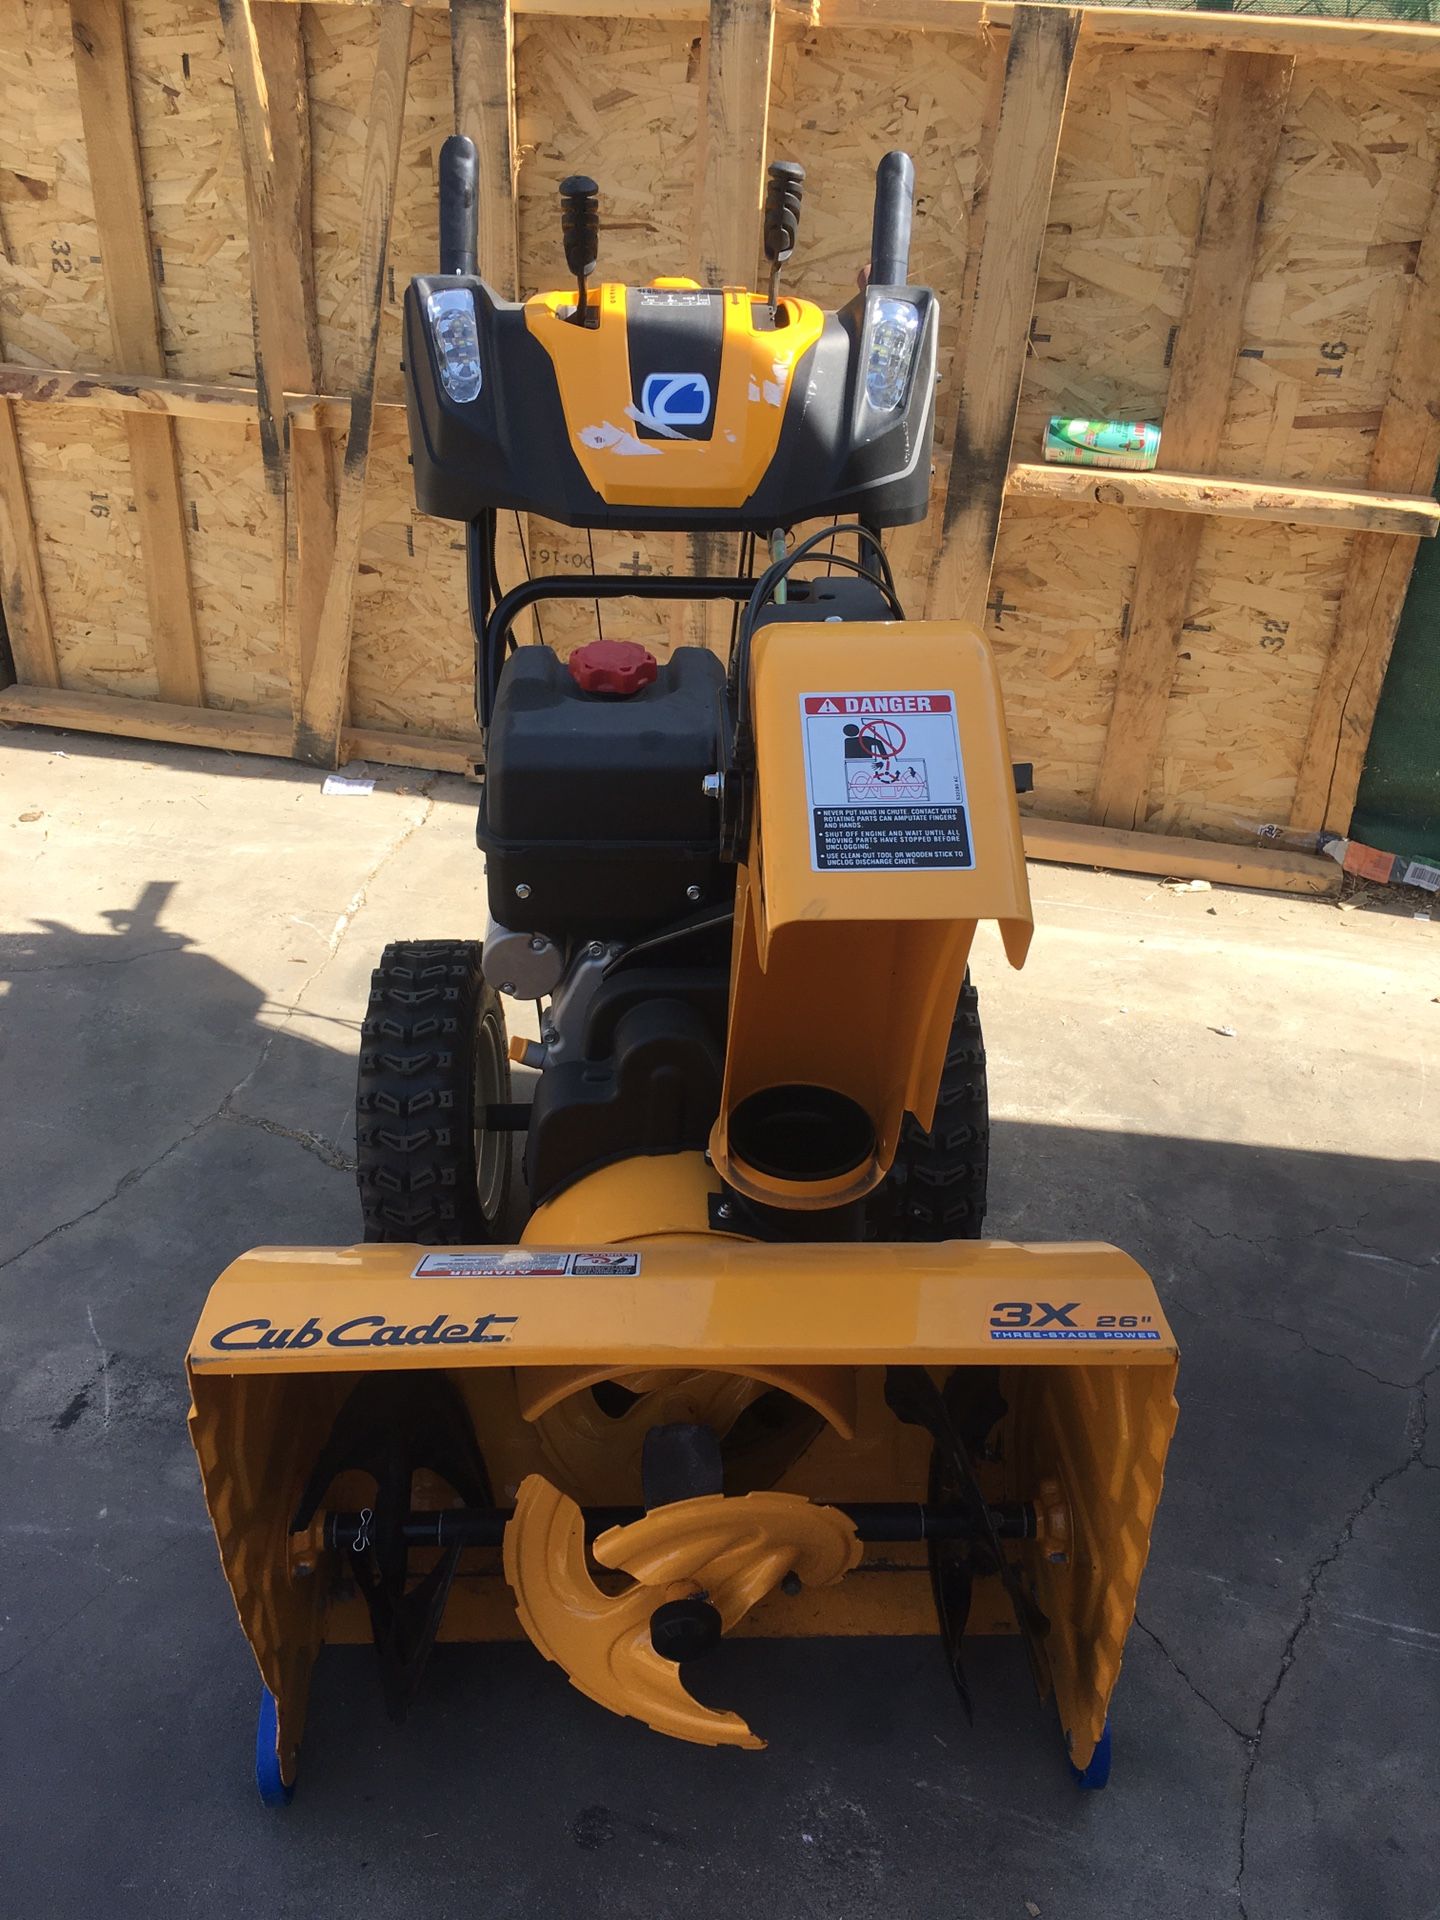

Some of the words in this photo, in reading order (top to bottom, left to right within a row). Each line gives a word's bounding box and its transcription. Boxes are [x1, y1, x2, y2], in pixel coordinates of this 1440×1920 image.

[51, 240, 72, 273] 32
[1315, 341, 1348, 378] 16
[89, 490, 110, 518] 16
[1260, 620, 1290, 654] 32
[845, 697, 932, 713] DANGER
[990, 1302, 1081, 1328] 3X
[1096, 1315, 1152, 1328] 26"
[210, 1317, 323, 1351] Cub
[326, 1312, 518, 1347] Cadet
[992, 1331, 1097, 1339] THREE-STAGE
[1103, 1331, 1158, 1339] POWER
